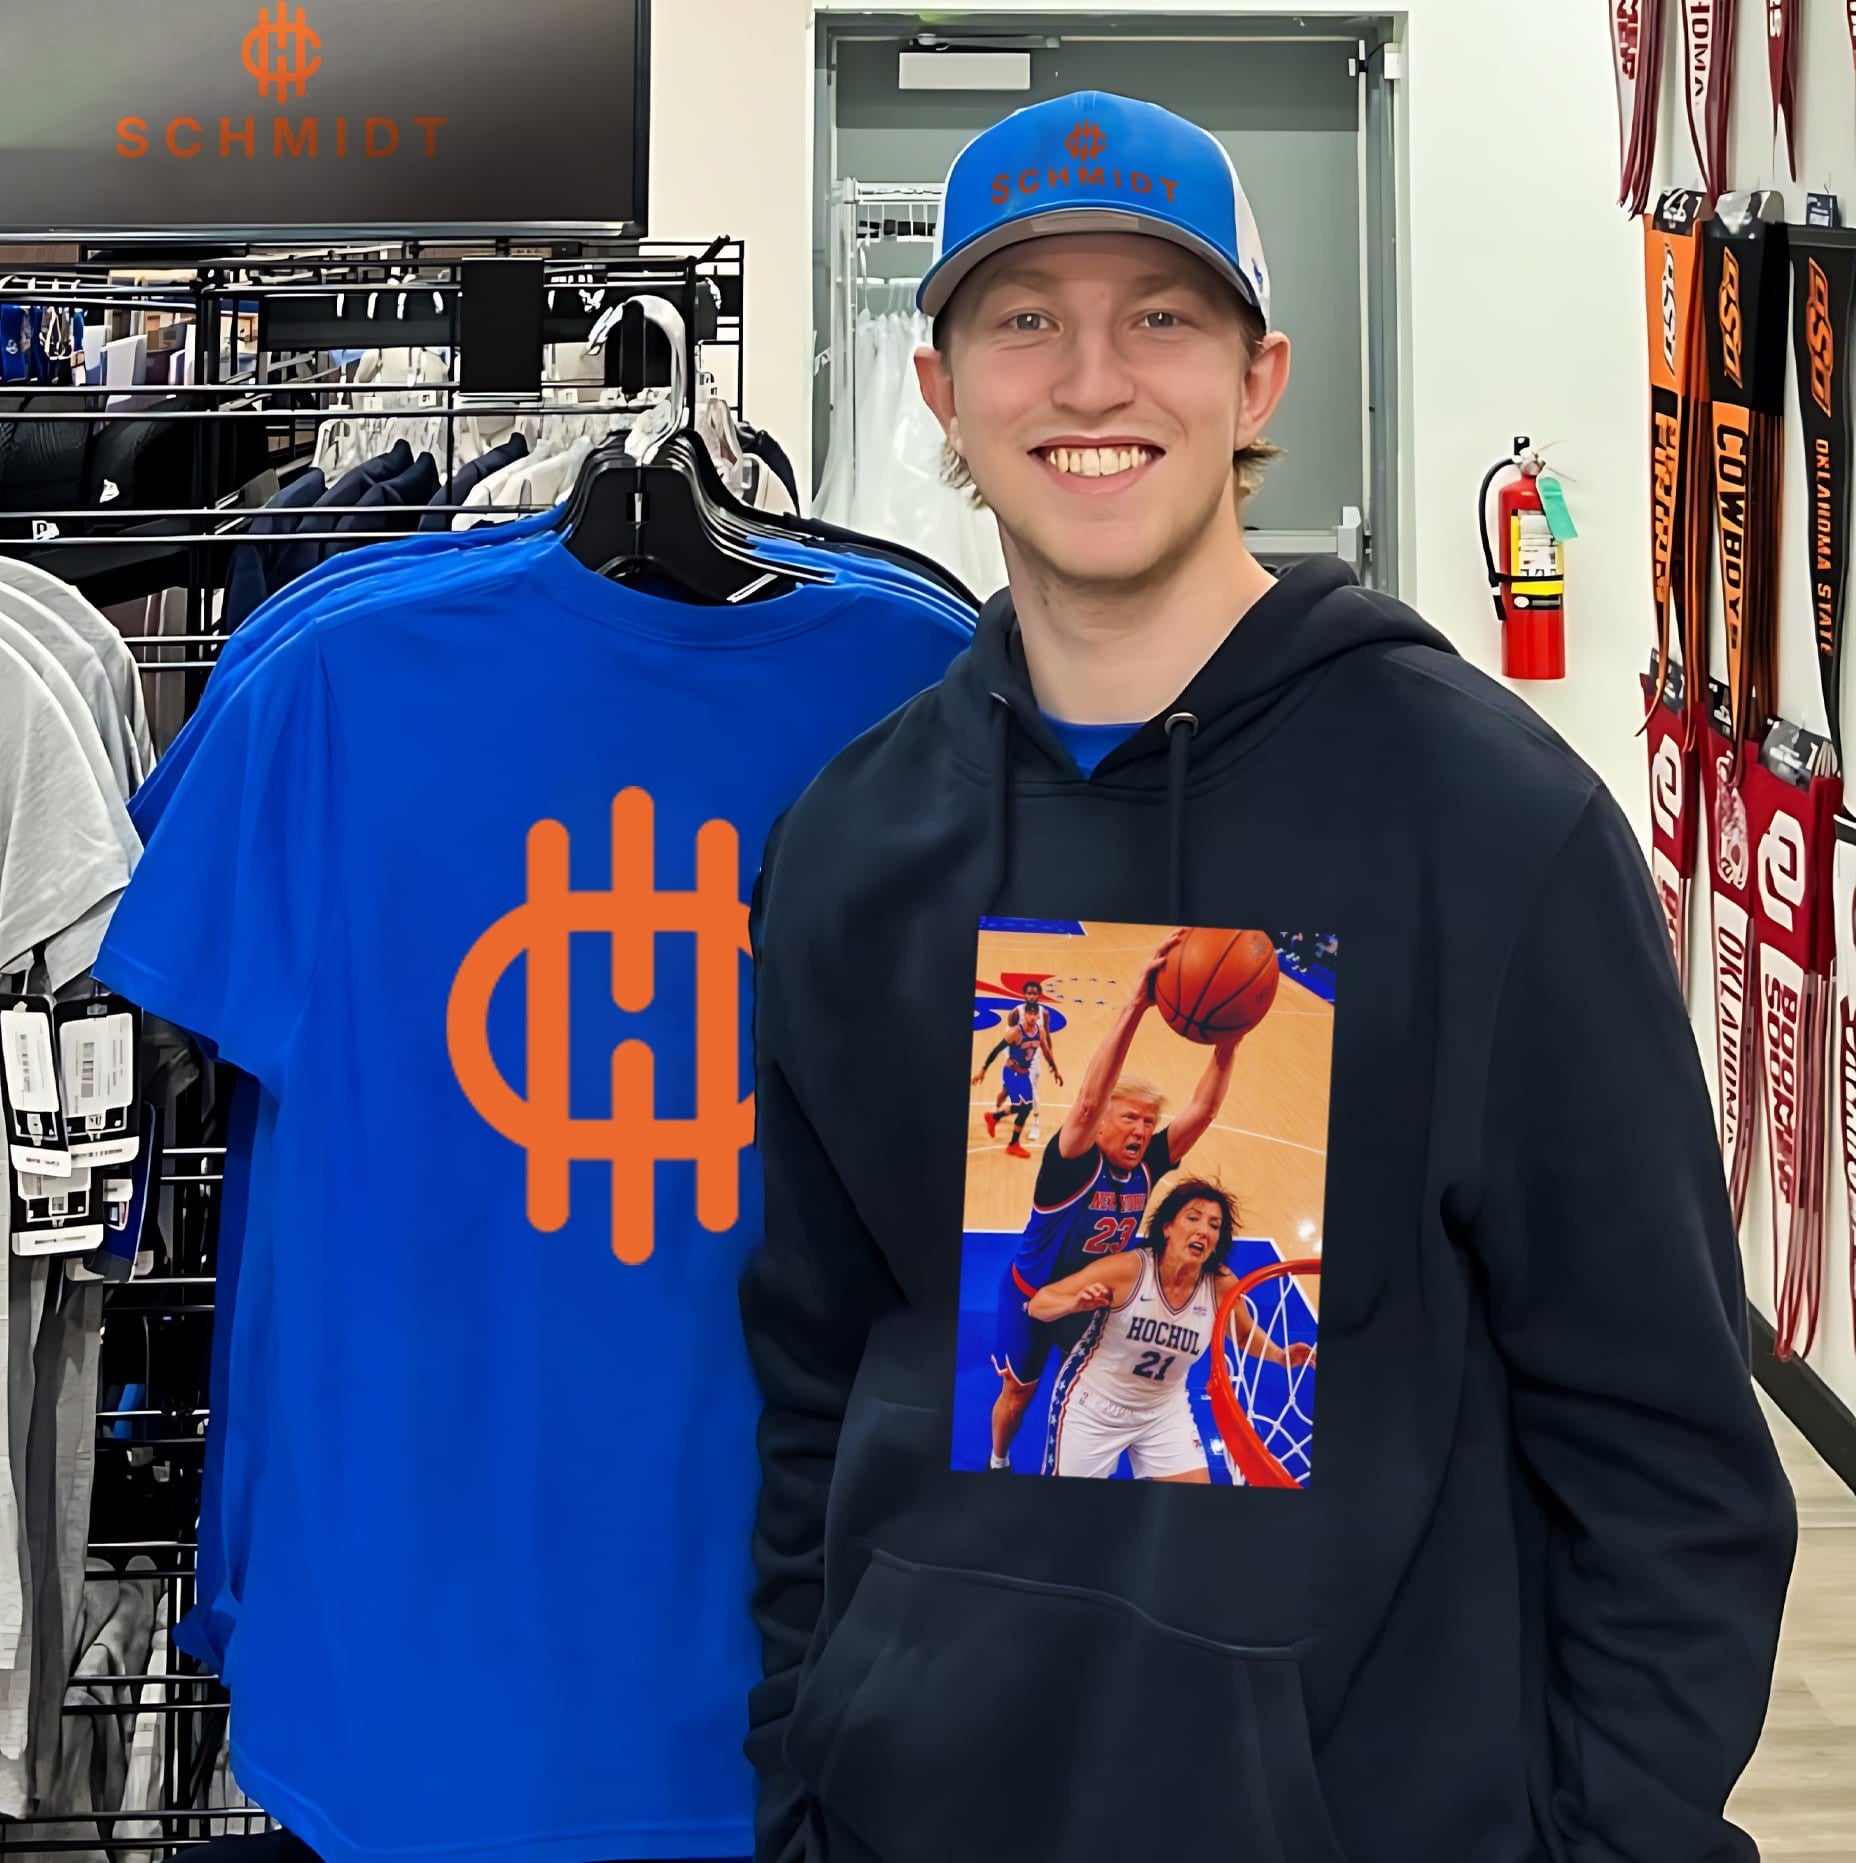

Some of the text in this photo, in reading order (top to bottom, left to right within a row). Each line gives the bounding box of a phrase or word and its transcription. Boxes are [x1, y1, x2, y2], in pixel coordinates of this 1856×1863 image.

[115, 116, 447, 159] SCHMIDT
[991, 167, 1179, 204] SCHMIDT
[1815, 438, 1832, 570] OKLAHOMA
[1718, 925, 1745, 1144] OKLAHOMA
[1082, 1216, 1138, 1254] 23
[1126, 1316, 1200, 1356] HOCHUL
[1132, 1350, 1177, 1381] 21
